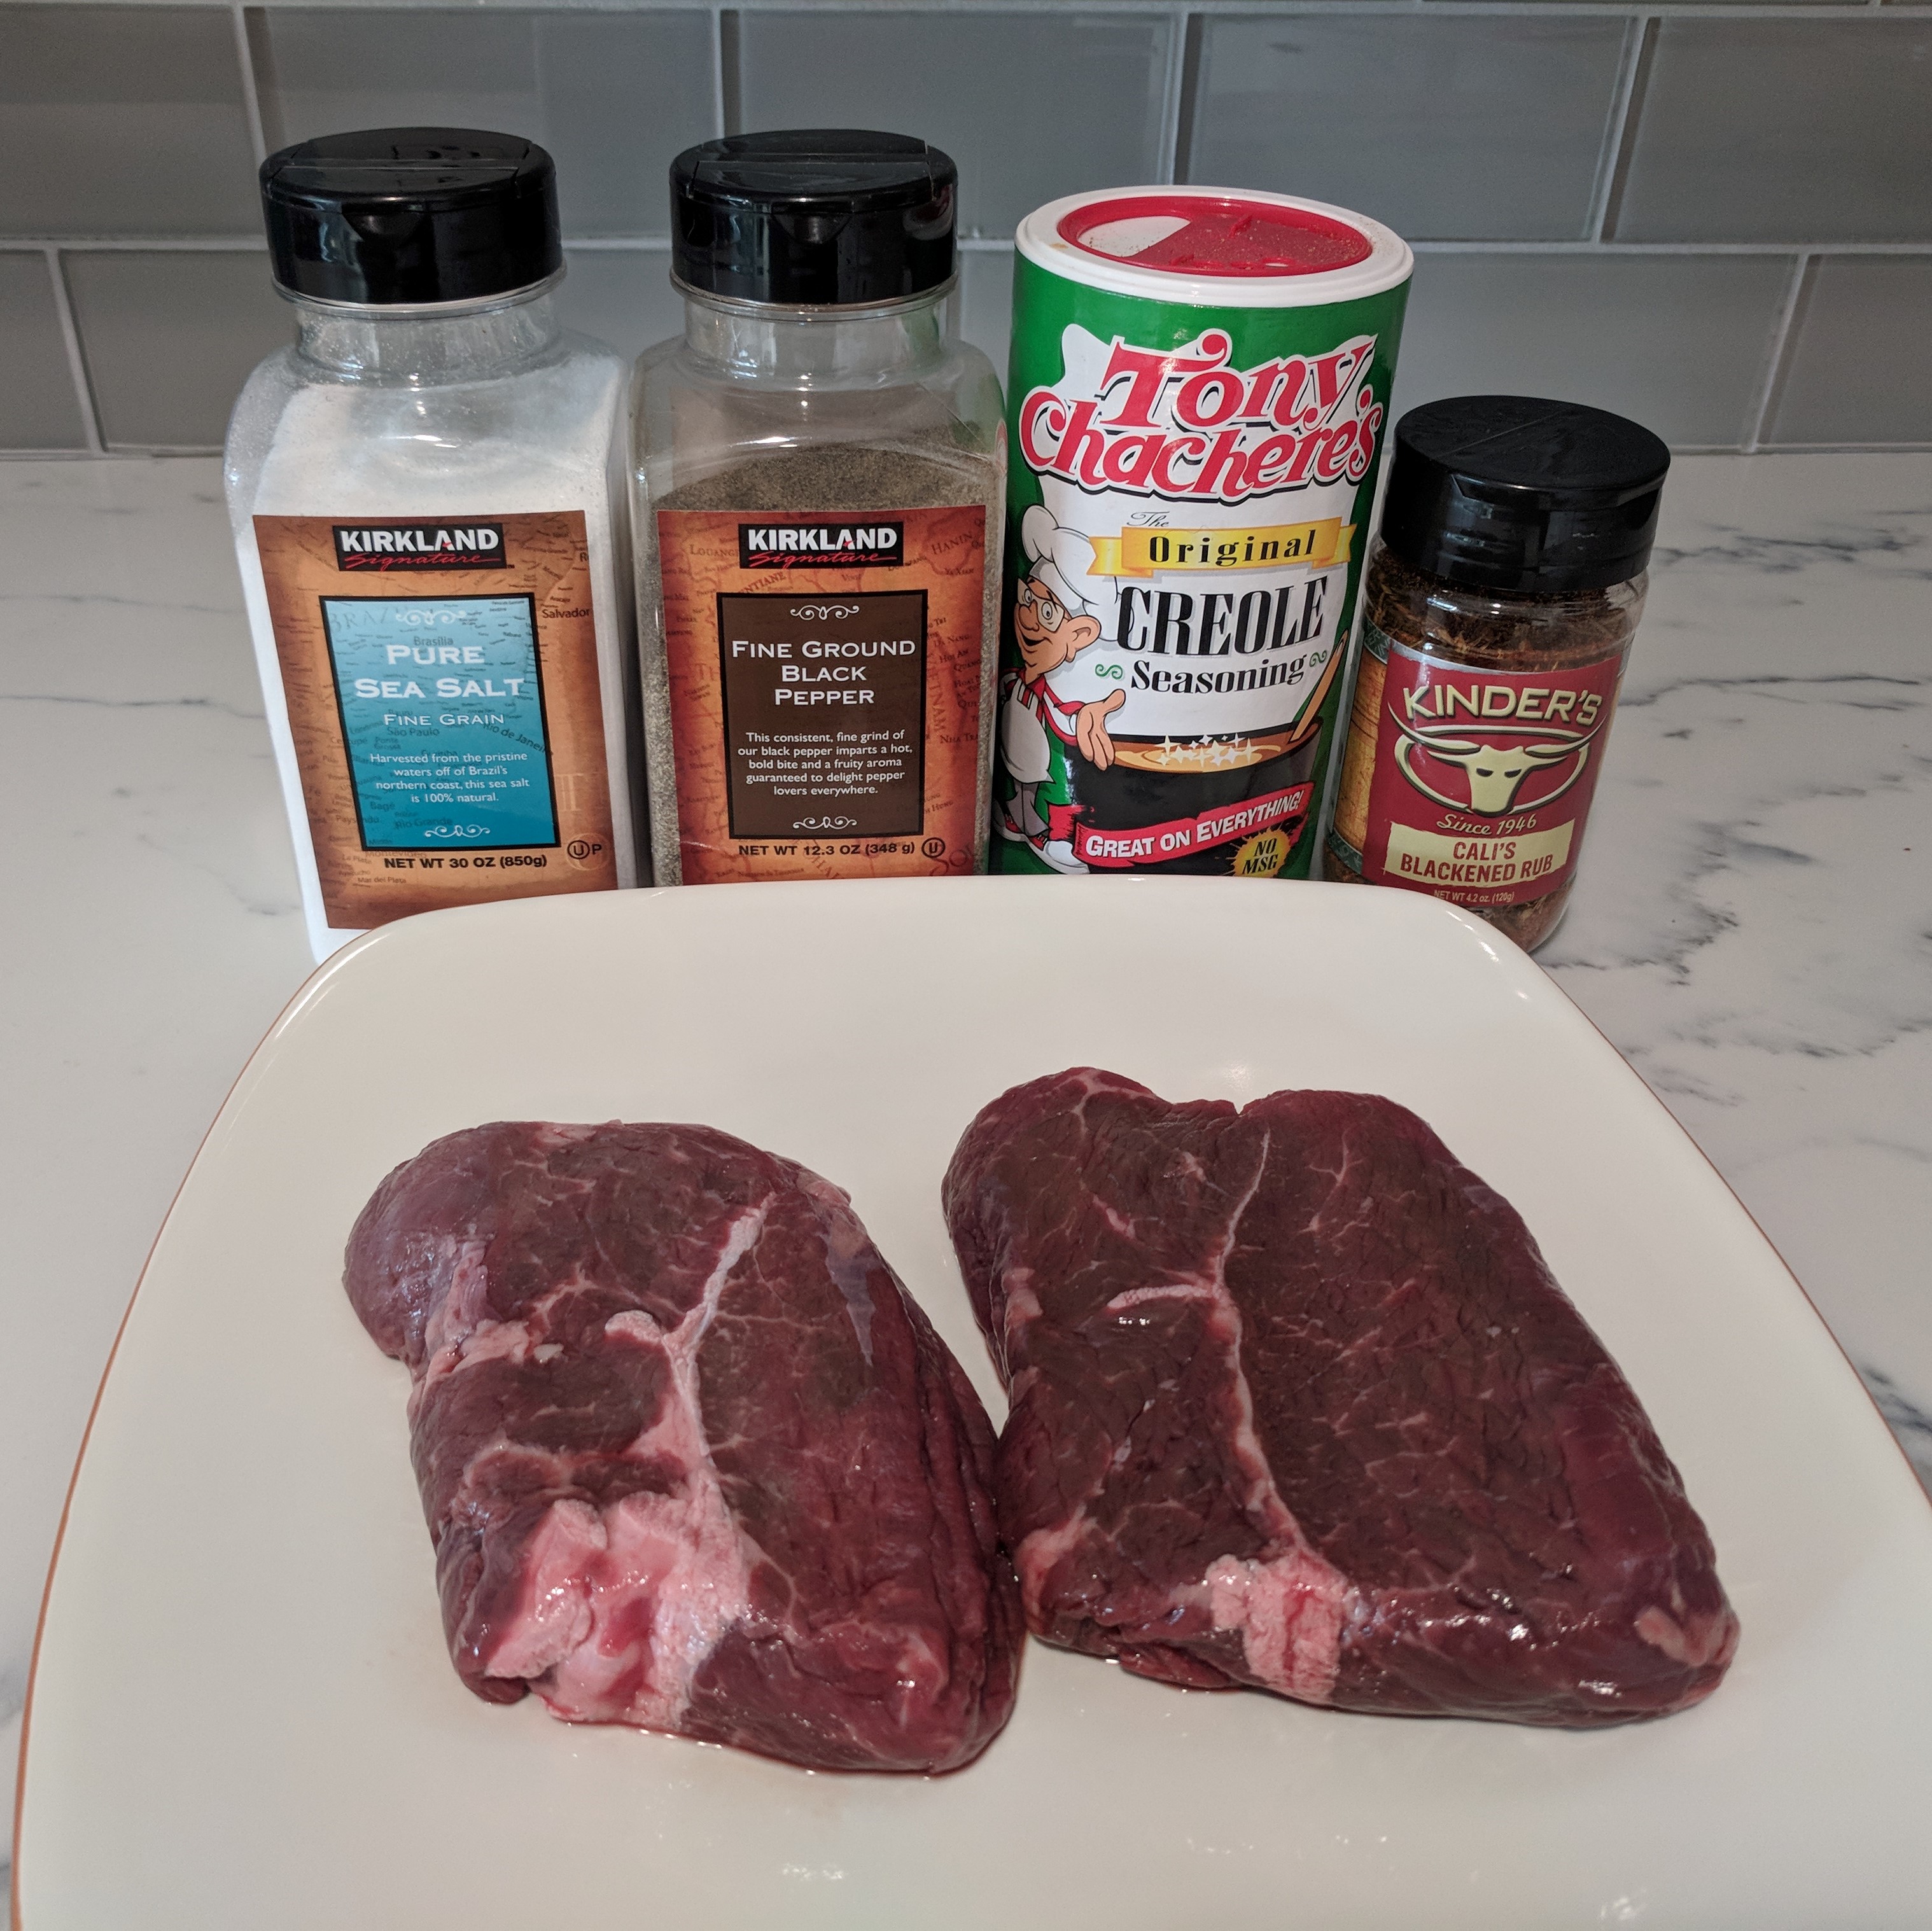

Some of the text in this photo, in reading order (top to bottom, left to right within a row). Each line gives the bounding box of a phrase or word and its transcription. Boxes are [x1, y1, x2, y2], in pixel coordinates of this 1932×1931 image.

[1100, 334, 1375, 429] Tony
[1019, 388, 1382, 497] Chachere's
[1126, 511, 1170, 527] The
[340, 529, 499, 552] KIRKLAND
[748, 528, 897, 551] KIRKLAND
[1150, 529, 1316, 567] Original
[344, 552, 501, 573] Signature
[749, 550, 897, 569] Signature
[542, 608, 590, 618] Salvador
[1117, 576, 1328, 655] CREOLE
[386, 645, 485, 665] PURE
[732, 640, 916, 659] FINE GROUND
[781, 665, 867, 683] BLACK
[1131, 654, 1308, 694] Seasoning
[354, 678, 524, 699] SEA SALT
[774, 688, 874, 706] PEPPER
[1403, 685, 1602, 726] KINDER'S
[384, 713, 505, 725] FINE GRAIN
[409, 726, 440, 737] Paulo
[501, 728, 515, 739] de
[746, 729, 905, 744] This consistent, fine grind of
[370, 753, 428, 763] Harvested
[431, 752, 459, 762] from
[463, 752, 481, 762] the
[486, 752, 528, 764] pristine
[761, 746, 790, 756] black
[794, 748, 832, 758] pepper
[836, 746, 878, 756] imparts
[890, 743, 913, 753] hot,
[394, 765, 508, 777] waters off of Brazil's
[748, 760, 773, 769] bold
[777, 760, 798, 769] bite
[801, 759, 822, 769] and
[834, 759, 864, 770] fruity
[866, 759, 902, 768] aroma
[375, 781, 427, 790] northern
[430, 781, 463, 790] coast,
[465, 779, 485, 789] this
[510, 778, 530, 788] salt
[746, 772, 906, 784] guaranteed to delight pepper
[411, 793, 499, 803] is 100% natural.
[774, 786, 878, 797] lovers everywhere.
[1086, 790, 1305, 858] GREAT ON EVERYTHING!
[1436, 814, 1537, 835] Since 1946
[739, 842, 915, 856] NET WT 12.3 OZ (348 g)
[1254, 837, 1277, 856] NO
[1453, 842, 1516, 861] CALI'S
[384, 854, 547, 869] NET WT 30 OZ (850g)
[1242, 854, 1278, 874] MSG
[1400, 853, 1554, 882] BLACKENED RUB
[1434, 889, 1450, 900] NET
[1452, 892, 1466, 902] WT
[1466, 893, 1478, 902] 4.2
[1492, 891, 1515, 903] (120g)
